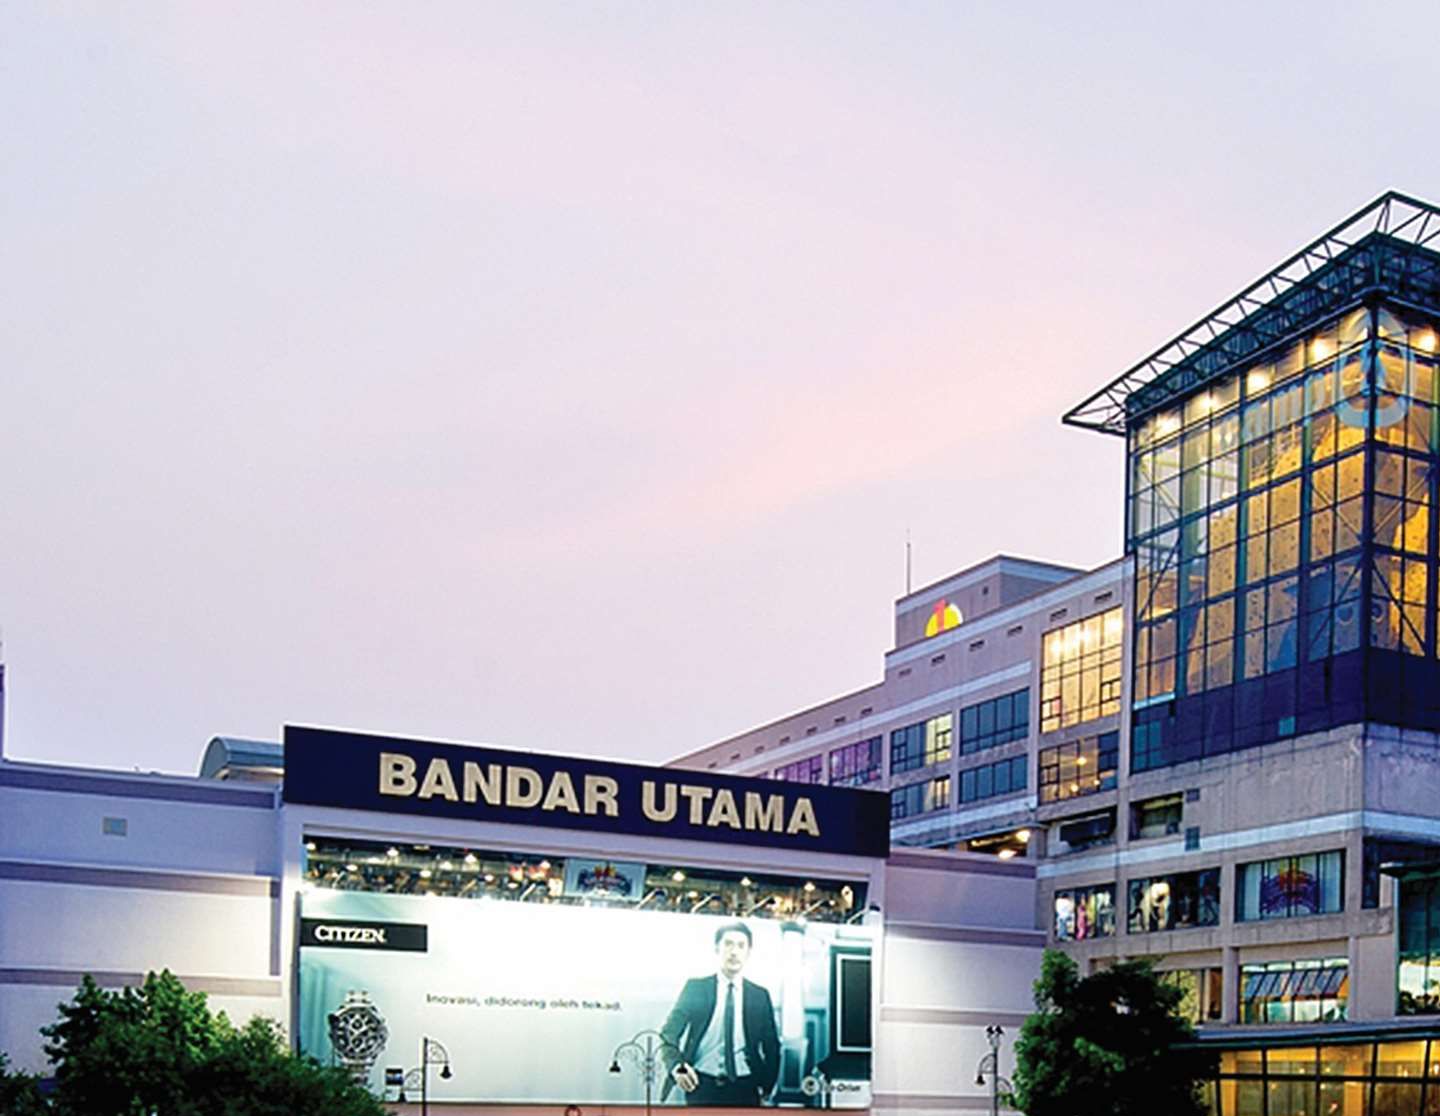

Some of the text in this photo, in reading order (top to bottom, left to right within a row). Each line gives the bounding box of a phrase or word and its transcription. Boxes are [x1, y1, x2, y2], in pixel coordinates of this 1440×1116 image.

[379, 752, 820, 837] BANDAR UTAMA
[314, 925, 387, 943] CITIZEN
